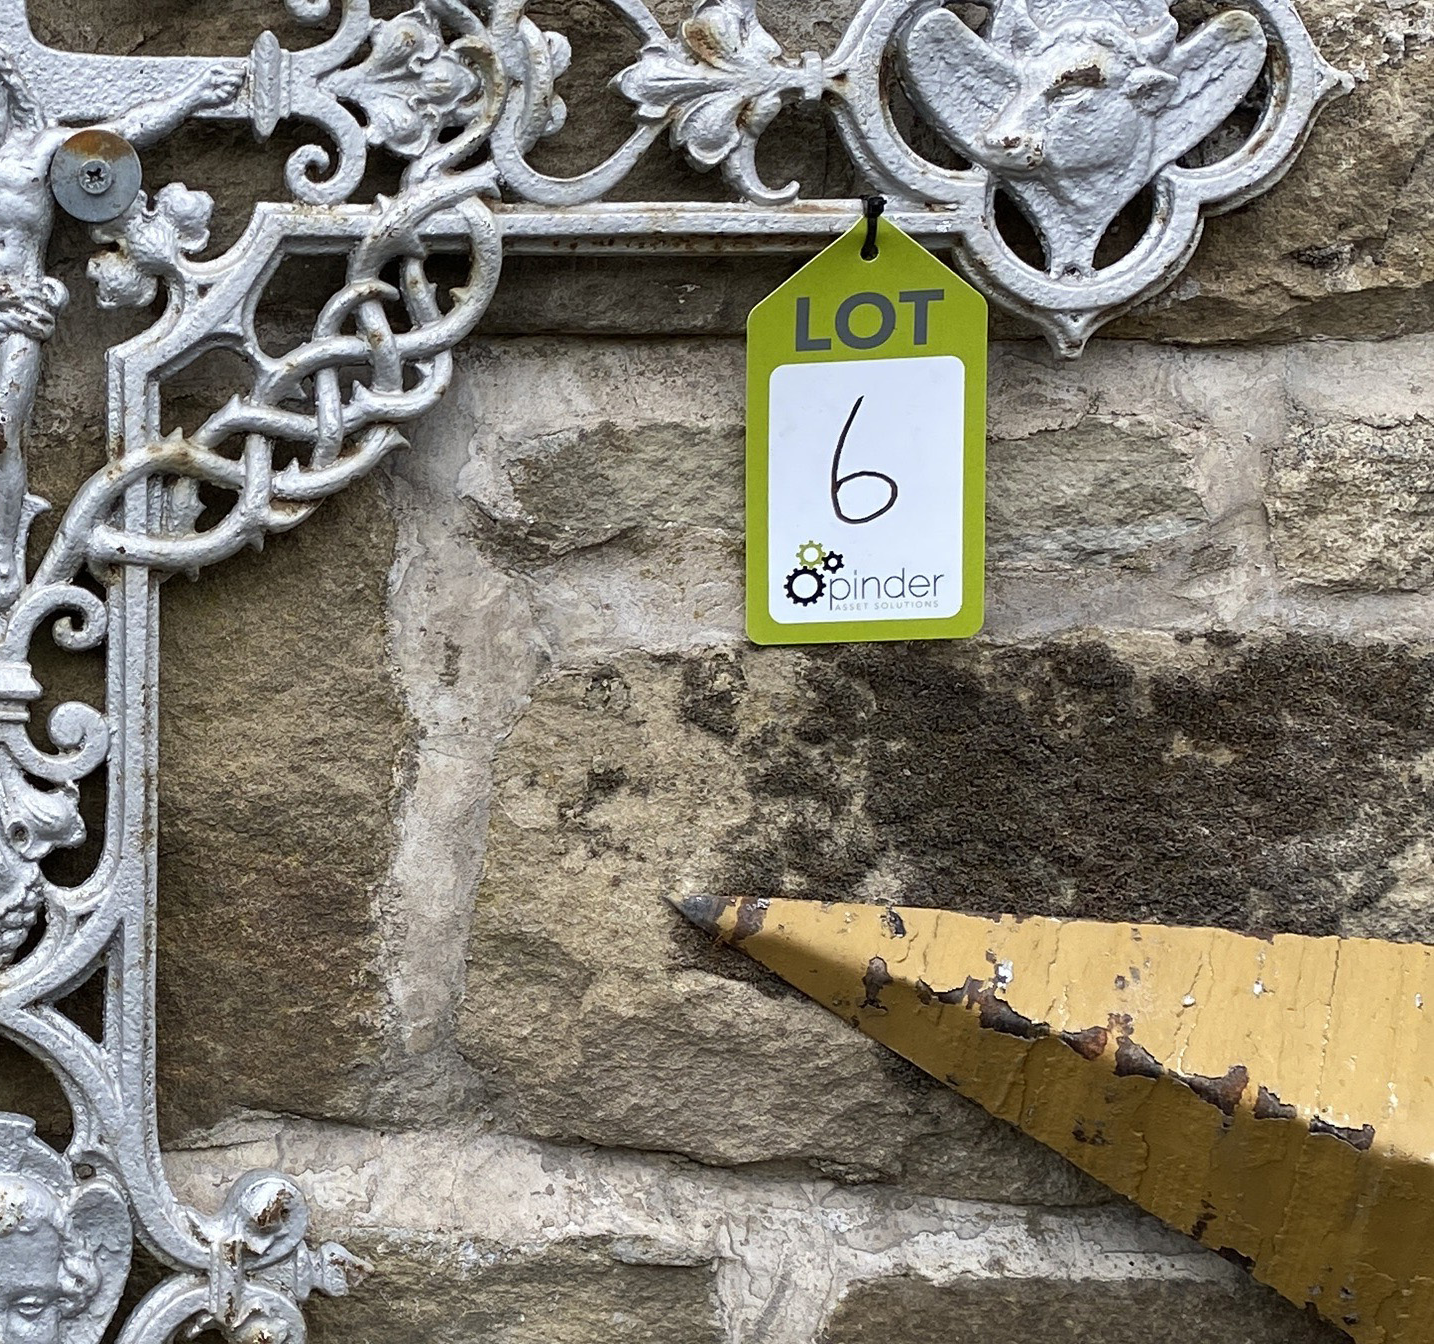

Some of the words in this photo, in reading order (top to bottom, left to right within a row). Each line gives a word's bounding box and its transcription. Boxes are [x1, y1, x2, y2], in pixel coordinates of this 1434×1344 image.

[795, 288, 945, 353] LOT
[830, 395, 898, 525] 6
[829, 567, 945, 611] pinder
[835, 603, 868, 612] ASSET
[874, 600, 939, 610] SOLUTIONS
